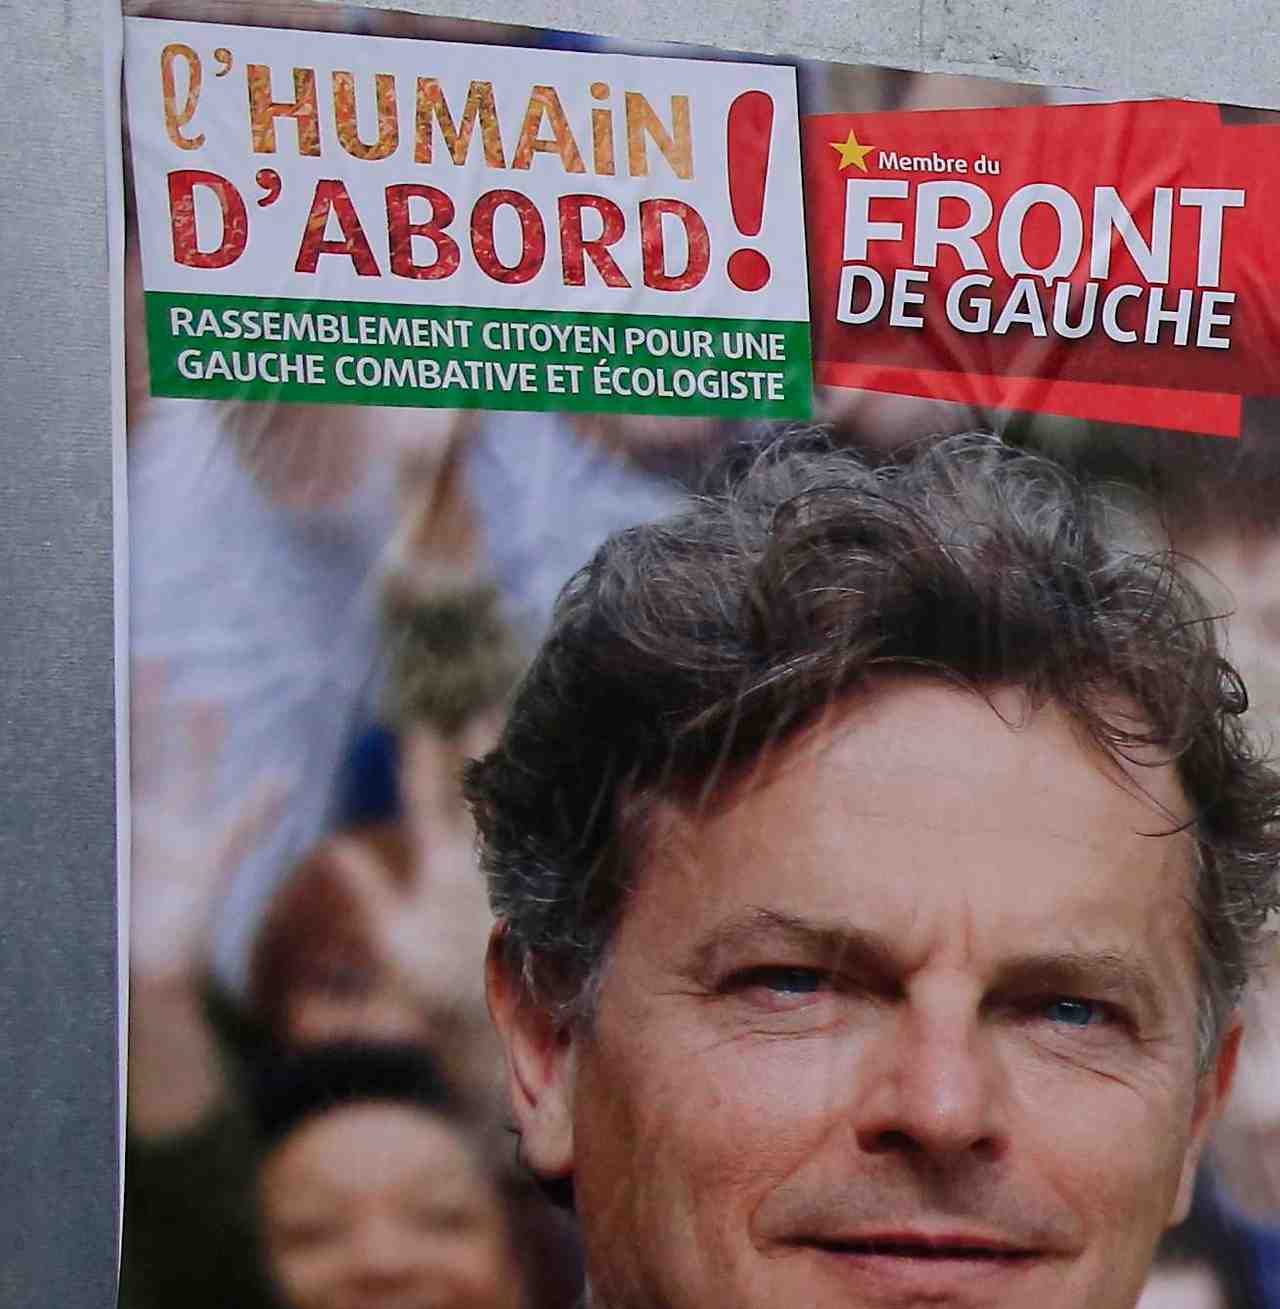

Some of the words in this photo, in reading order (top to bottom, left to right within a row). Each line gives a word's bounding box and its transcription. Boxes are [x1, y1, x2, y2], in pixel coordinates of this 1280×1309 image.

[878, 152, 967, 174] Membre
[974, 155, 1000, 175] du
[842, 179, 1245, 288] FRONT
[170, 307, 473, 350] RASSEMBLEMENT
[481, 321, 617, 355] CITOYEN
[625, 328, 714, 359] POUR
[721, 332, 786, 361] UNE
[835, 265, 929, 329] DE
[945, 274, 1236, 349] GAUCHE
[178, 348, 326, 384] GAUCHE
[336, 355, 538, 393] COMBATIVE
[546, 364, 581, 394] ET
[592, 359, 785, 401] ÉCOLOGISTE
